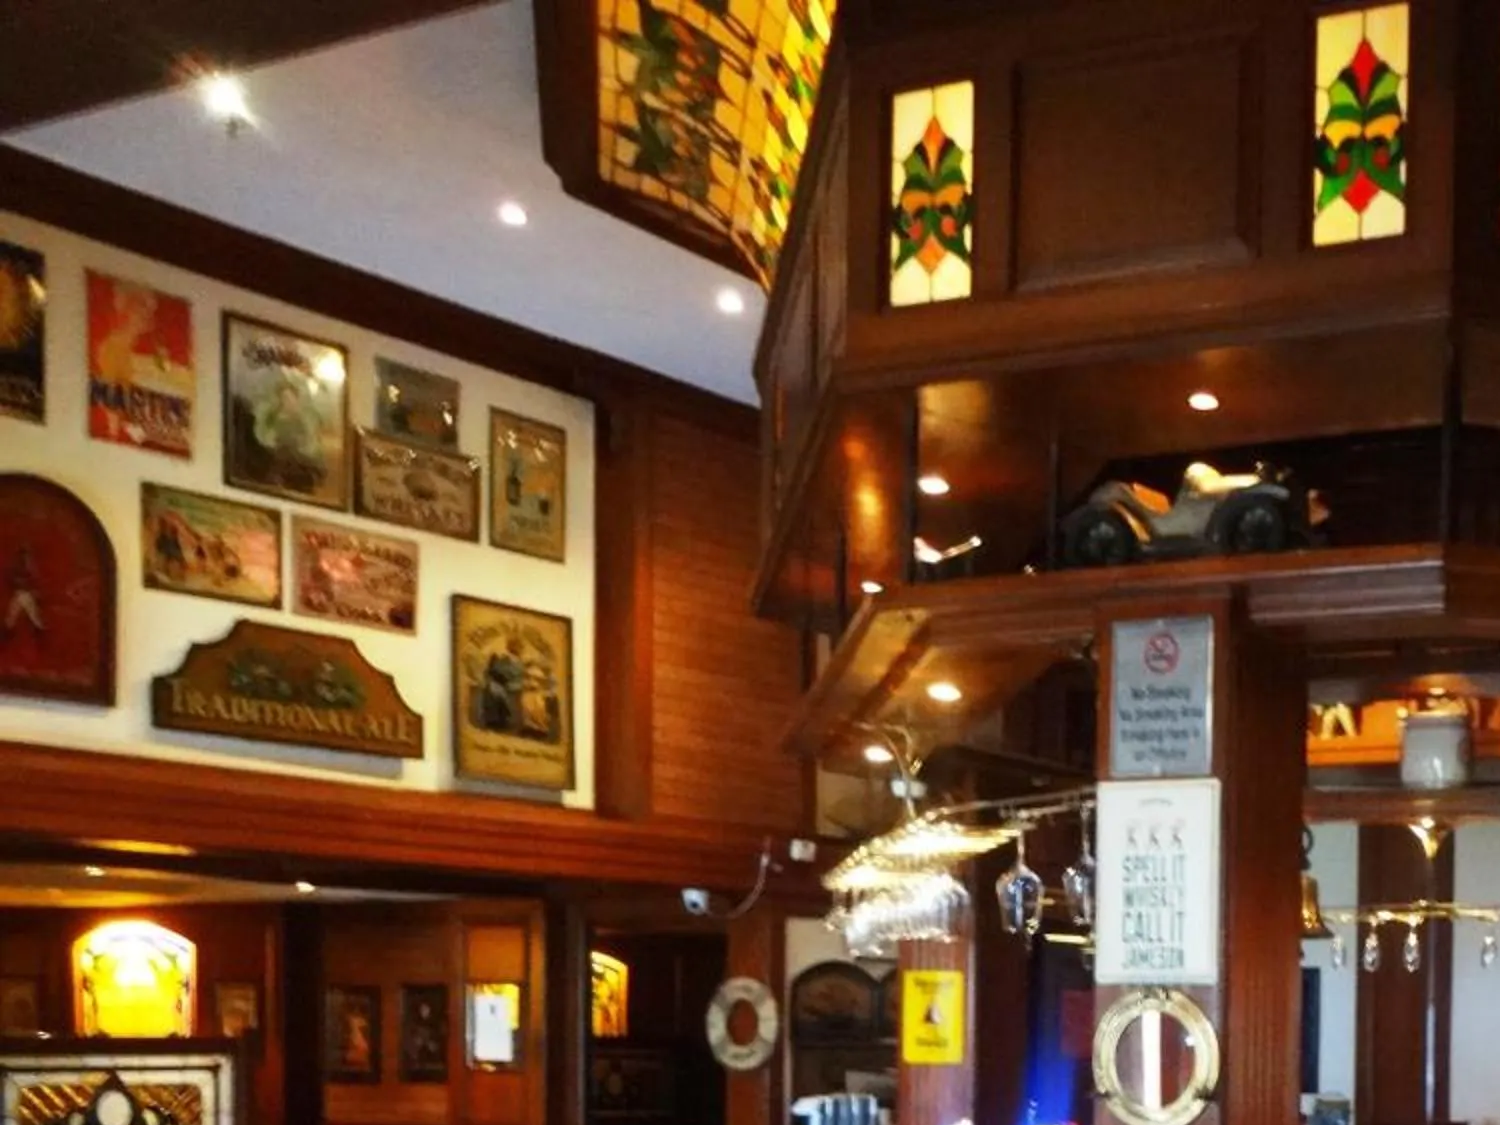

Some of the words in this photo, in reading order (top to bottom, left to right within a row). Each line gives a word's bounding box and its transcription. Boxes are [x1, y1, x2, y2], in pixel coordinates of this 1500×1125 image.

[172, 679, 357, 737] TRADITIONAL
[1122, 855, 1167, 883] SPELL
[1171, 854, 1186, 883] IT
[1122, 885, 1185, 908] WHISKEY
[1122, 911, 1164, 943] CALL
[1169, 911, 1185, 943] IT
[1122, 946, 1184, 970] JAMESON
